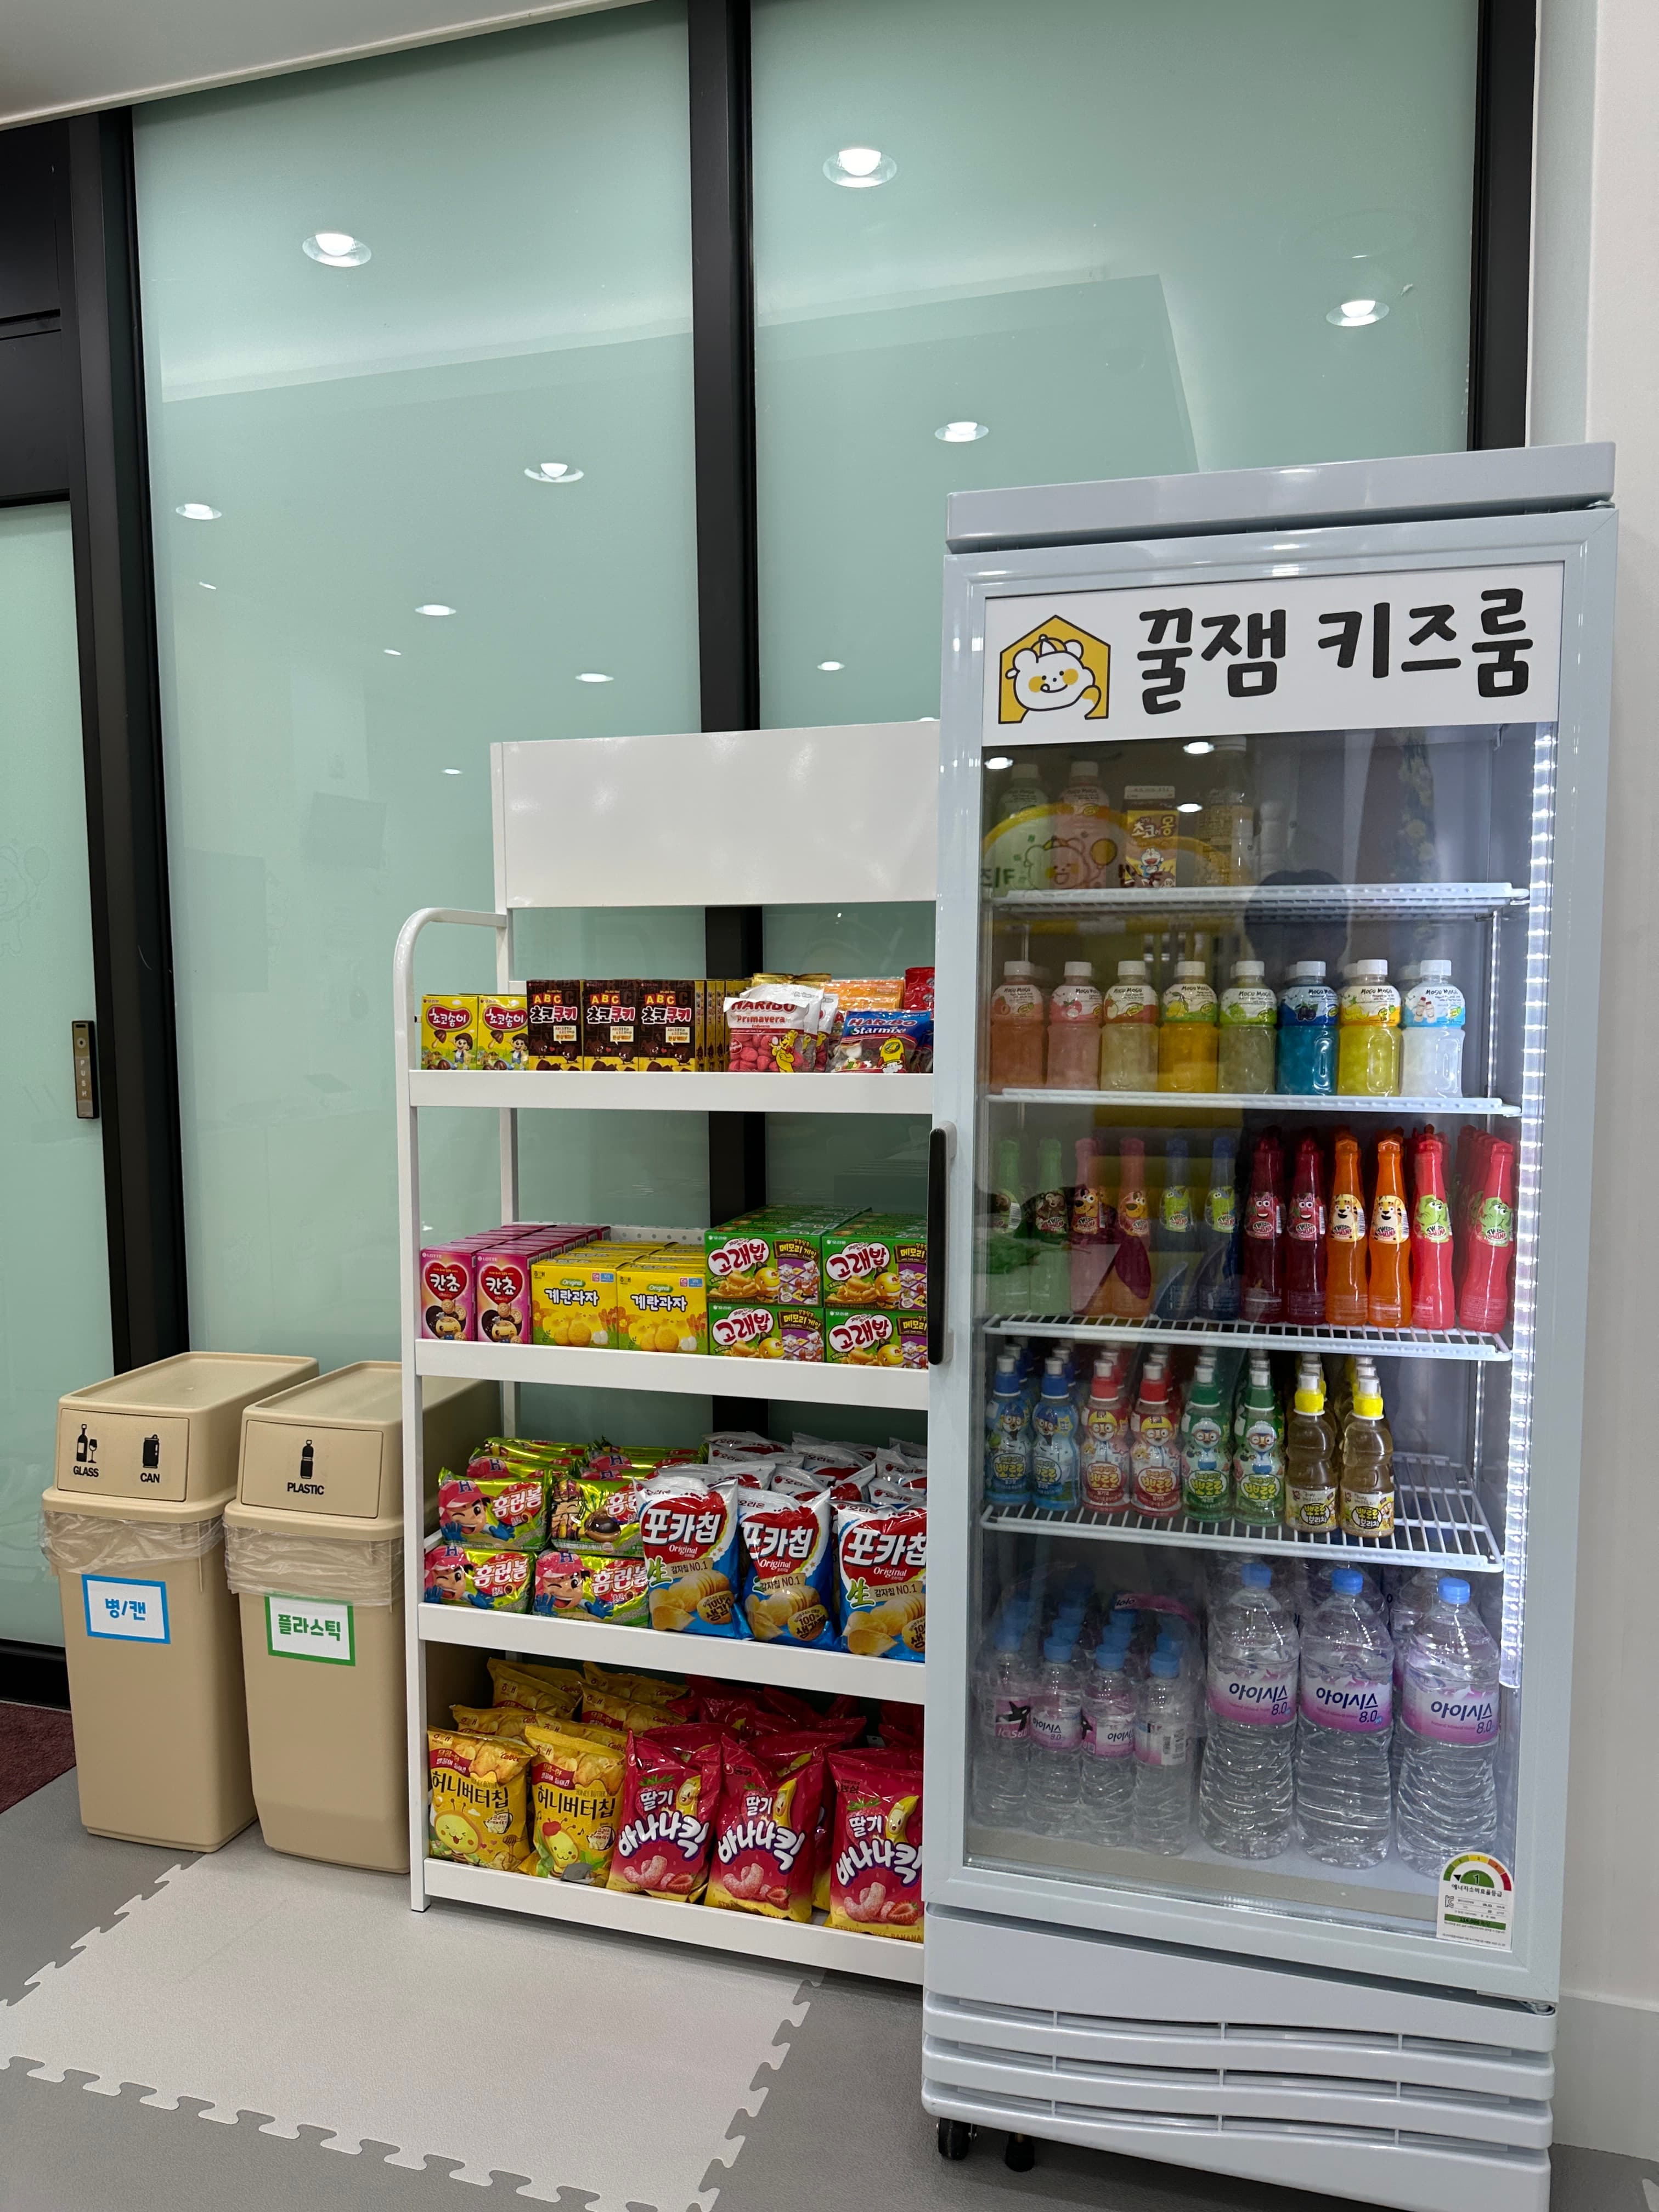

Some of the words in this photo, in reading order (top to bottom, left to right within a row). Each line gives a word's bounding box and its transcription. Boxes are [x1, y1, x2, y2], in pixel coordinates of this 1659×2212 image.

[1137, 606, 1286, 715] 꿀잼
[1317, 588, 1534, 698] 키즈룸
[533, 994, 561, 1003] ABC
[591, 995, 619, 1004] ABC
[646, 995, 675, 1005] ABC
[731, 1001, 797, 1012] HARIBO
[429, 1008, 466, 1028] 초코송이
[486, 1008, 524, 1028] 초코송이
[530, 1006, 578, 1023] 초코쿠키
[587, 1006, 635, 1024] 초코쿠키
[641, 1006, 691, 1024] 초코쿠키
[848, 1018, 917, 1026] HARIBO
[852, 1026, 904, 1035] Starmix
[711, 1243, 766, 1273] 고래밥
[779, 1244, 803, 1254] 메모리
[804, 1248, 817, 1259] 게임
[900, 1248, 924, 1259] 메모리
[830, 1247, 886, 1278] 고래밥
[430, 1273, 460, 1292] 칸쵸
[486, 1276, 516, 1295] 칸쵸
[545, 1288, 600, 1306] 계란과자
[630, 1294, 687, 1312] 계란과자
[716, 1313, 770, 1342] 고래밥
[783, 1314, 806, 1324] 메모리
[808, 1319, 821, 1330] 게임
[903, 1321, 927, 1330] 메모리
[832, 1319, 889, 1350] 고래밥
[73, 1466, 99, 1478] GLASS
[140, 1472, 160, 1483] CAN
[287, 1482, 325, 1495] PLASTIC
[459, 1481, 473, 1493] H
[492, 1485, 543, 1518] 홈런볼
[739, 1499, 765, 1509] 오리온
[1304, 1504, 1326, 1516] 뽀로로
[1308, 1516, 1327, 1524] 보리차
[1356, 1508, 1379, 1519] 뽀로로
[642, 1509, 721, 1545] 포카칩
[1360, 1519, 1379, 1527] 보리차
[741, 1521, 814, 1559] 포카칩
[844, 1527, 927, 1566] 포카칩
[445, 1546, 459, 1556] H
[560, 1553, 573, 1563] H
[669, 1544, 698, 1555] Original
[647, 1556, 673, 1585] 生
[671, 1565, 689, 1574] 감자칩
[690, 1561, 709, 1572] NO.1
[759, 1558, 791, 1570] Original
[873, 1567, 907, 1578] Original
[473, 1558, 529, 1588] 홈런볼
[591, 1566, 647, 1594] 홈런볼
[760, 1579, 780, 1591] 감자칩
[782, 1576, 801, 1586] NO.1
[874, 1588, 895, 1597] 감자칩
[896, 1583, 917, 1594] NO.1
[847, 1578, 874, 1607] 生
[105, 1598, 146, 1621] 병/캔
[278, 1613, 341, 1641] 플라스틱
[1229, 1683, 1288, 1703] 아이시스
[1316, 1687, 1378, 1709] 아이시스
[1271, 1702, 1288, 1716] 8.0
[1359, 1709, 1378, 1723] 8.0
[1431, 1701, 1493, 1721] 아이시스
[1033, 1717, 1062, 1733] 아이시스
[1476, 1720, 1492, 1734] 8.0
[500, 1753, 521, 1762] Calbee
[432, 1770, 509, 1809] 허니버터칩
[538, 1785, 616, 1820] 허니버터칩
[640, 1790, 674, 1811] 딸기
[746, 1796, 773, 1816] 딸기
[618, 1811, 710, 1859] 바나나킥
[849, 1815, 882, 1838] 딸기
[718, 1820, 805, 1871] 바나나킥
[836, 1839, 923, 1886] 바나나킥
[1474, 1874, 1480, 1885] 1
[1452, 1883, 1502, 1898] 에너지소비효율등급
